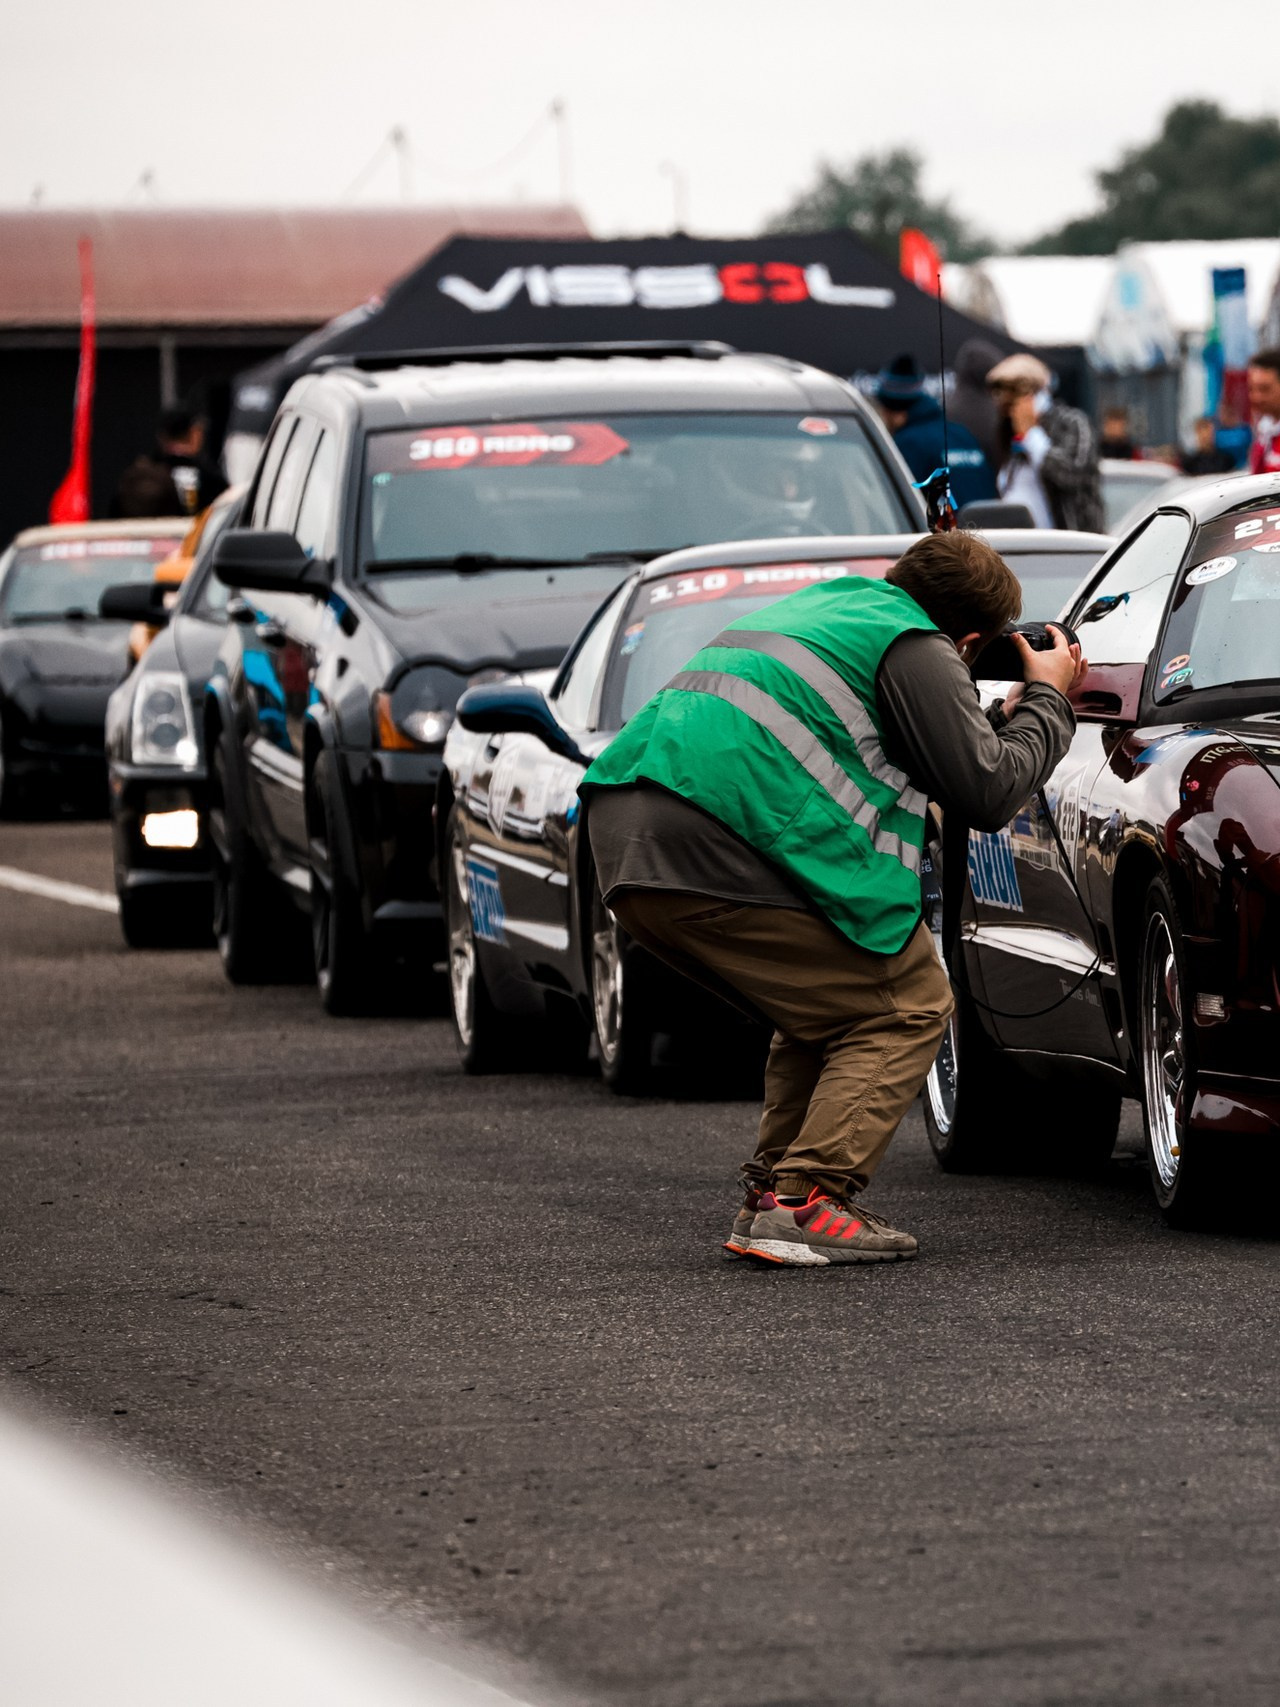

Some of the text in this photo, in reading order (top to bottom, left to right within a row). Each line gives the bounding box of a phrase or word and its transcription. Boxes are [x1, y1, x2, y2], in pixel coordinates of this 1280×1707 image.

[439, 263, 895, 312] VISSOL
[409, 436, 480, 460] 360
[650, 572, 729, 604] 110
